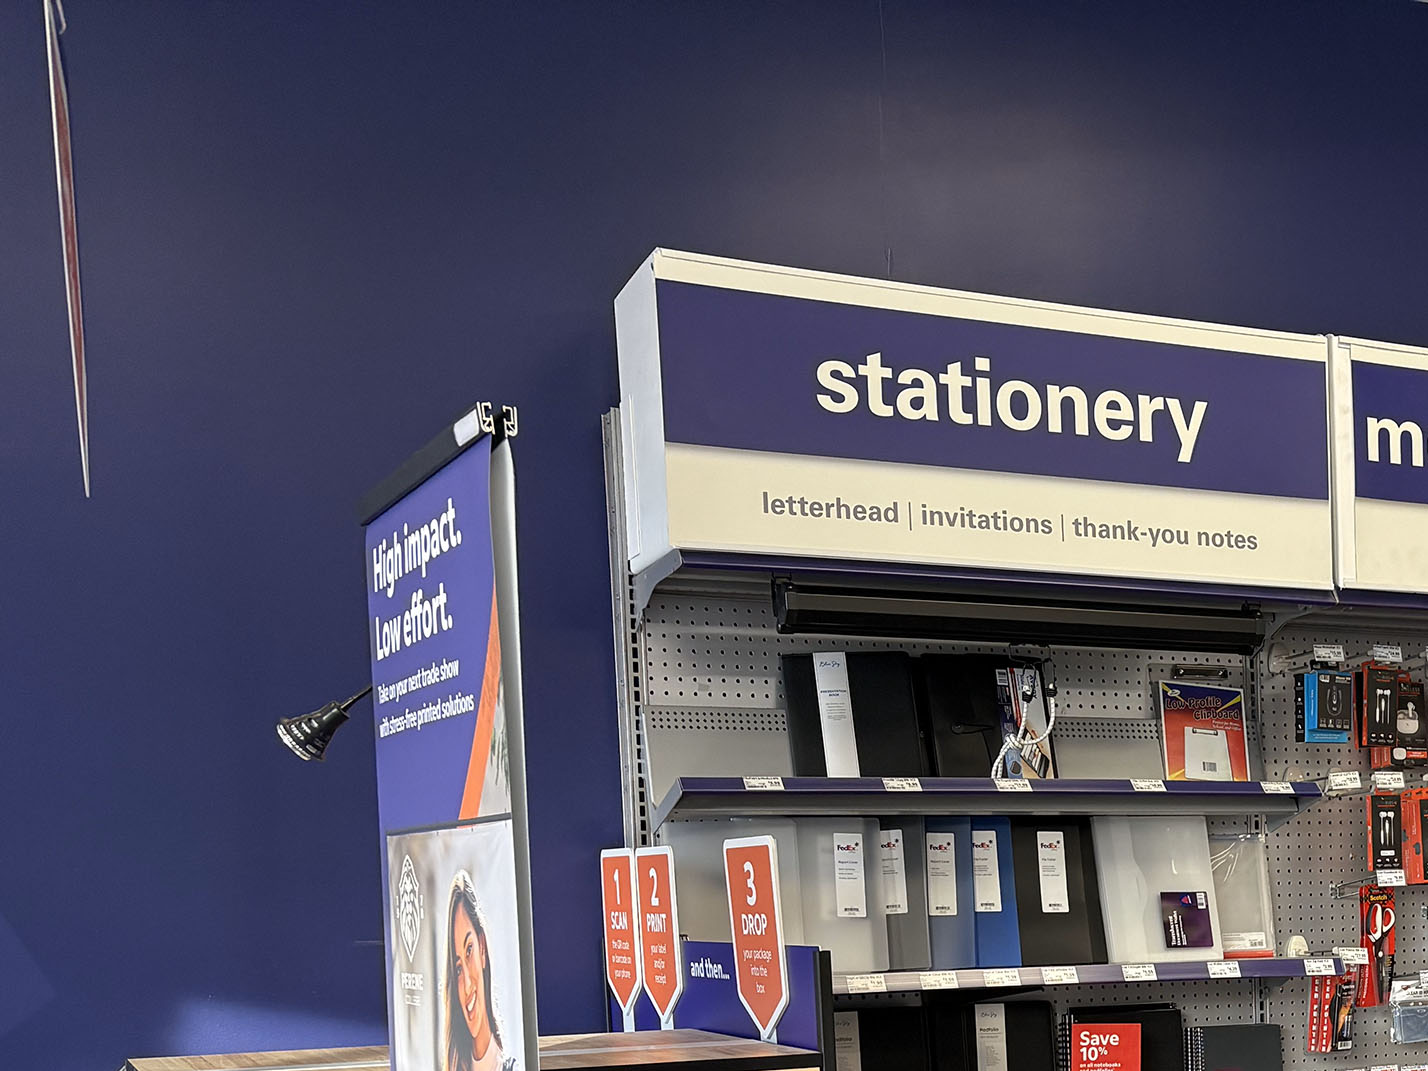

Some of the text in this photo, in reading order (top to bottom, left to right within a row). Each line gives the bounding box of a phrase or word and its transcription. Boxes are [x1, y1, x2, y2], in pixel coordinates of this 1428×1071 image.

[815, 352, 1207, 463] stationery
[761, 491, 1258, 551] letterhead invitations thank-you notes
[371, 497, 462, 598] High impact.
[375, 582, 453, 661] Low effort.
[406, 673, 421, 694] next
[421, 665, 440, 690] trade
[439, 658, 459, 683] show
[416, 698, 441, 729] printed
[441, 690, 475, 723] solutions
[1166, 696, 1222, 710] Low Profile
[1193, 709, 1240, 721] Clipboard
[613, 868, 621, 904] 1
[650, 868, 660, 906] 2
[743, 861, 757, 906] 3
[610, 912, 628, 930] SCAN
[646, 914, 667, 934] PRINT
[742, 913, 768, 936] DROP
[690, 958, 730, 980] and then...
[743, 950, 772, 962] your package
[1080, 1030, 1120, 1047] Save
[1080, 1046, 1108, 1062] 10%
